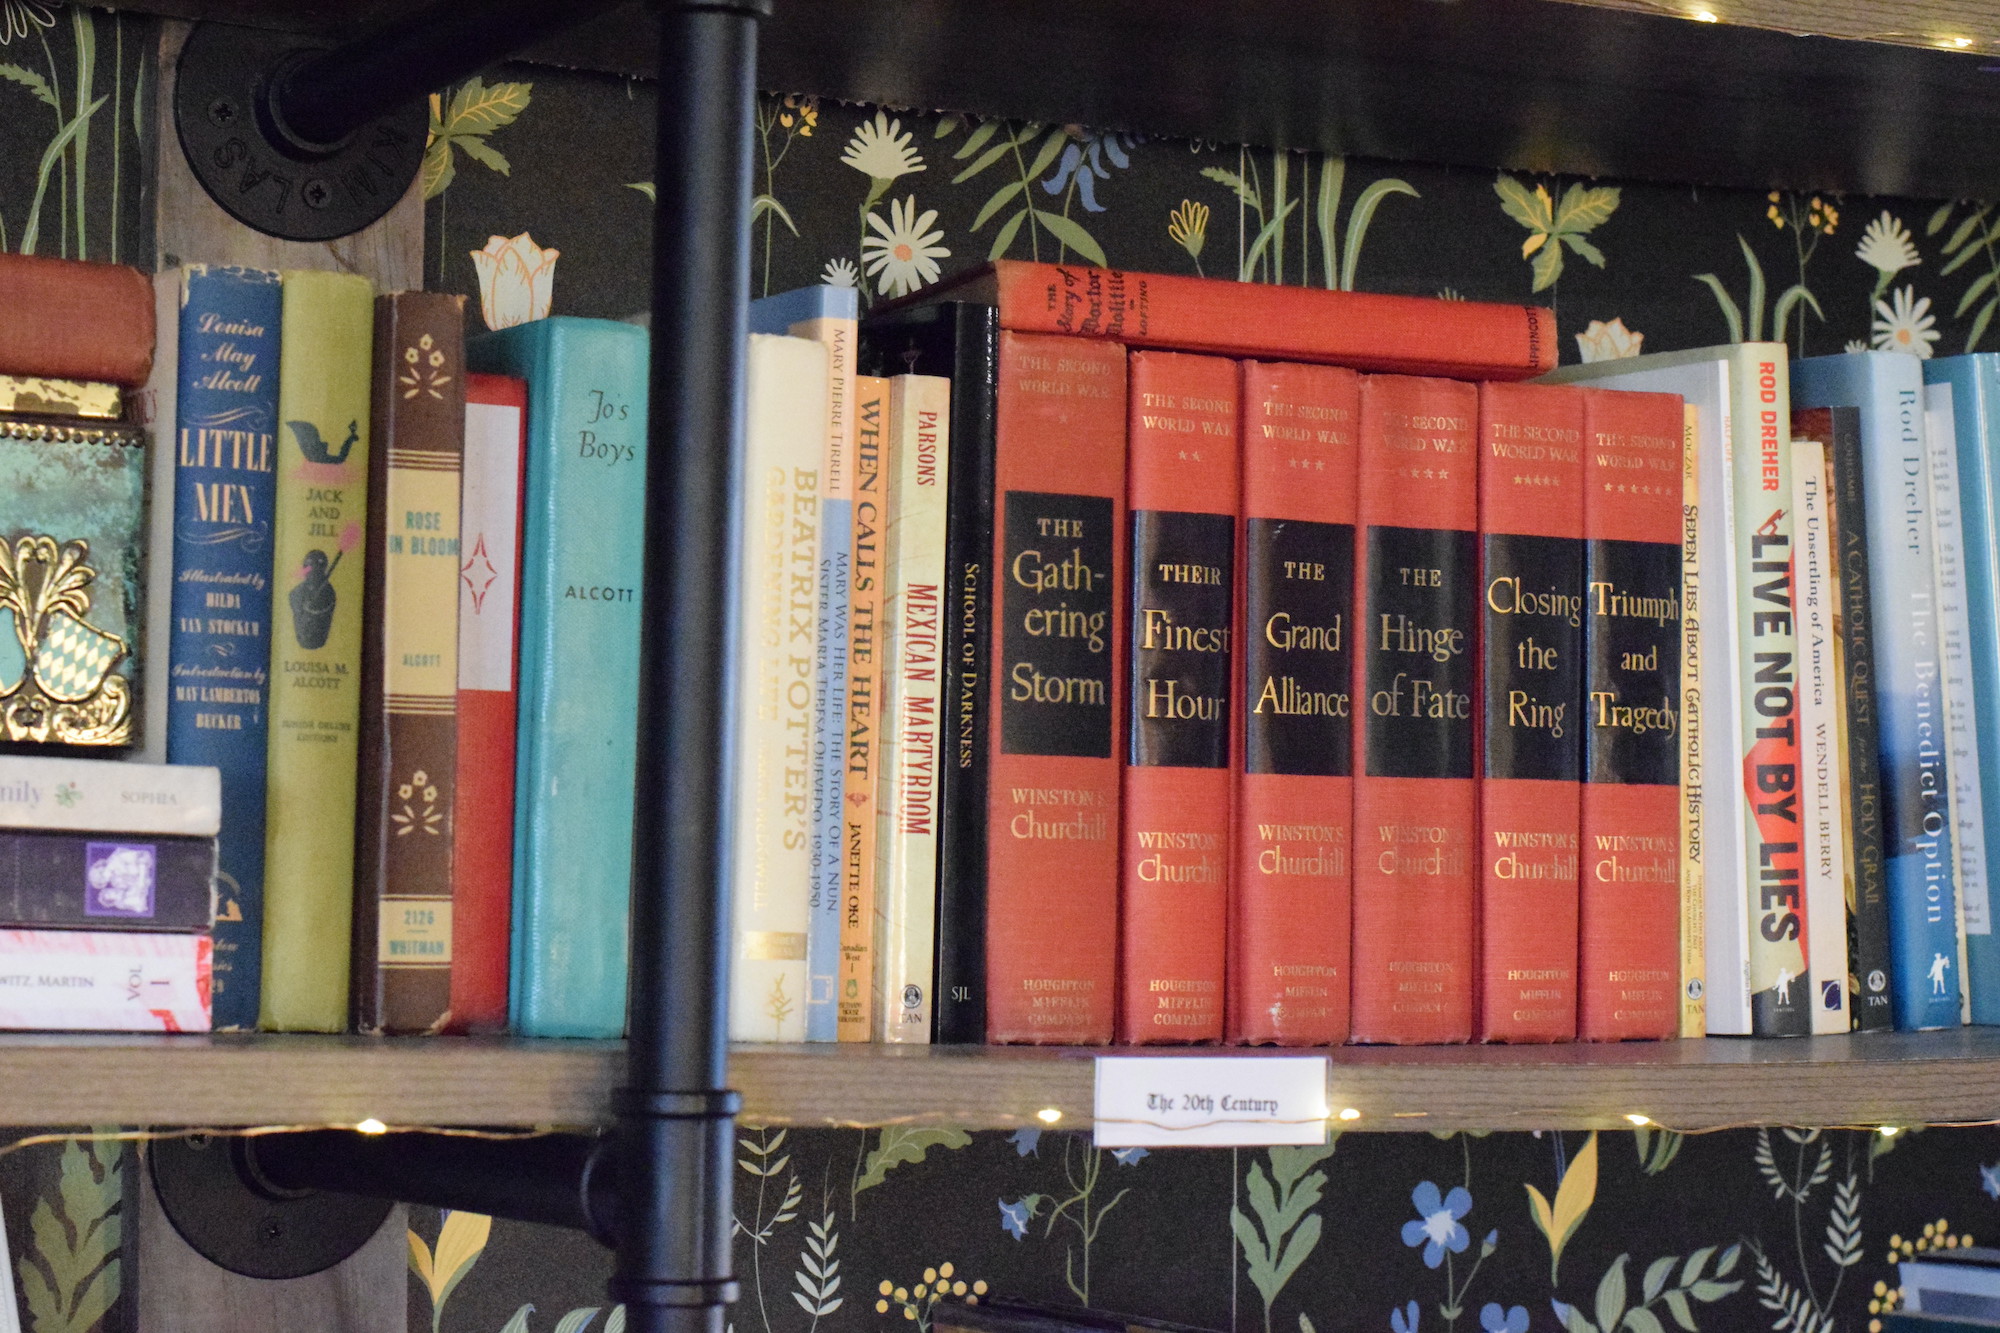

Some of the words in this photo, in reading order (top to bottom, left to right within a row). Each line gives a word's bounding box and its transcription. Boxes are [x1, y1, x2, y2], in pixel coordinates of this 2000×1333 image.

[1048, 284, 1057, 312] THE
[1056, 289, 1082, 334] Story
[1104, 271, 1125, 337] Dolittle
[1139, 280, 1148, 337] LOFTING
[198, 312, 264, 339] Louisa
[1528, 306, 1539, 368] LIPPINCOTT
[200, 342, 256, 370] May
[833, 328, 846, 375] MARY
[193, 370, 262, 394] Alcott
[1758, 362, 1776, 403] ROD
[587, 390, 630, 424] Jo's
[831, 377, 845, 430] PIERRE
[1143, 393, 1175, 408] THE
[1182, 396, 1232, 415] SECOND
[1143, 415, 1195, 434] WORLD
[1264, 401, 1293, 416] THE
[1298, 405, 1348, 421] SECOND
[1899, 390, 1919, 442] Rod
[180, 428, 273, 473] LITTLE
[578, 429, 637, 468] Boys
[858, 398, 881, 494] WHEN
[917, 410, 938, 486] PARSONS
[1261, 425, 1311, 441] WORLD
[1316, 430, 1349, 445] WAR
[1492, 423, 1520, 438] THE
[1524, 427, 1580, 443] SECOND
[1492, 443, 1545, 460] WORLD
[1550, 447, 1579, 463] WAR
[1684, 425, 1693, 480] MOCZAR
[1760, 411, 1779, 492] DREHER
[829, 433, 844, 493] TIRRELL
[193, 482, 255, 524] MEN
[305, 487, 342, 502] JACK
[309, 505, 340, 520] AND
[1805, 476, 1818, 512] The
[1902, 457, 1923, 555] Dreher
[307, 523, 338, 537] JILL
[405, 511, 441, 532] ROSE
[1037, 518, 1083, 538] THE
[1683, 504, 1699, 564] SEVEN
[1846, 531, 1860, 546] A
[388, 534, 403, 555] IN
[410, 535, 460, 557] BLOOM
[789, 465, 818, 644] BEATRIX
[854, 500, 877, 592] CALLS
[1806, 516, 1821, 607] Unsettling
[819, 558, 832, 612] SISTER
[835, 552, 849, 596] MARY
[1012, 548, 1105, 593] Gath-
[1158, 563, 1222, 586] THEIR
[1284, 561, 1326, 581] THE
[1400, 567, 1442, 588] THE
[1752, 534, 1792, 637] LIVE
[565, 584, 634, 603] ALCOTT
[963, 562, 980, 638] SCHOOL
[1487, 576, 1582, 628] Closing
[1590, 581, 1680, 628] Triumph
[1684, 571, 1699, 613] LIES
[1847, 550, 1867, 656] CATHOLIC
[833, 601, 848, 641] WAS
[853, 602, 875, 665] THE
[902, 583, 938, 683] MEXICAN
[1023, 602, 1105, 653] ering
[1142, 608, 1231, 654] Finest
[1265, 612, 1341, 654] Grand
[1811, 612, 1821, 632] of
[1911, 584, 1933, 645] The
[817, 617, 830, 671] MARIA
[962, 642, 977, 664] OF
[1380, 613, 1464, 662] Hinge
[1517, 637, 1558, 671] the
[1684, 616, 1701, 682] ABOUT
[284, 661, 330, 673] LOUISA
[402, 652, 441, 668] ALCOTT
[832, 645, 847, 684] HER
[1620, 646, 1658, 672] and
[1811, 636, 1823, 706] America
[292, 677, 341, 690] ALCOTT
[1011, 662, 1105, 705] Storm
[1146, 679, 1225, 721] Hour
[1253, 675, 1349, 718] Alliance
[1371, 673, 1407, 718] of
[1411, 680, 1471, 720] Fate
[1754, 652, 1795, 747] NOT
[1851, 659, 1871, 725] QUEST
[831, 690, 845, 725] LIFE:
[849, 674, 872, 780] HEART
[960, 672, 978, 769] DARKNESS
[1508, 690, 1566, 739] Ring
[1590, 691, 1680, 741] Tragedy
[830, 729, 844, 763] THE
[1685, 688, 1701, 780] CATHOLIC
[1914, 661, 1941, 801] Benedict
[781, 654, 812, 851] POTTER'S
[899, 696, 935, 837] MARTYRDOM
[1815, 723, 1830, 815] WENDELL
[121, 791, 177, 806] SOPHIA
[828, 769, 843, 819] STORY
[1011, 788, 1095, 806] WINSTON
[1756, 763, 1797, 823] BY
[1859, 784, 1876, 840] HOLY
[827, 823, 841, 849] OF
[1010, 810, 1107, 841] Churchill
[1137, 831, 1217, 849] WINSTON
[1258, 824, 1334, 842] WINSTON
[1494, 831, 1567, 849] WINSTON
[1595, 835, 1666, 852] WINSTON
[1686, 783, 1703, 864] HISTORY
[827, 852, 840, 867] A
[849, 822, 862, 893] JANETTE
[1258, 845, 1344, 877] Churchill
[1494, 852, 1577, 882] Churchill
[1595, 856, 1676, 884] Churchill
[1819, 821, 1833, 880] BERRY
[1916, 811, 1946, 923] Option
[1759, 842, 1800, 943] LIES
[1861, 848, 1880, 904] GRAIL
[848, 894, 859, 929] OKE
[388, 939, 445, 956] WHITMAN
[38, 976, 94, 988] MARTIN
[127, 965, 144, 1002] VOL
[951, 985, 972, 1002] SJL
[1868, 996, 1888, 1007] TAN
[900, 1013, 923, 1024] TAN
[1687, 1004, 1704, 1015] TAN
[1147, 1093, 1174, 1115] The
[1182, 1094, 1214, 1115] 20th
[1220, 1094, 1279, 1116] Century
